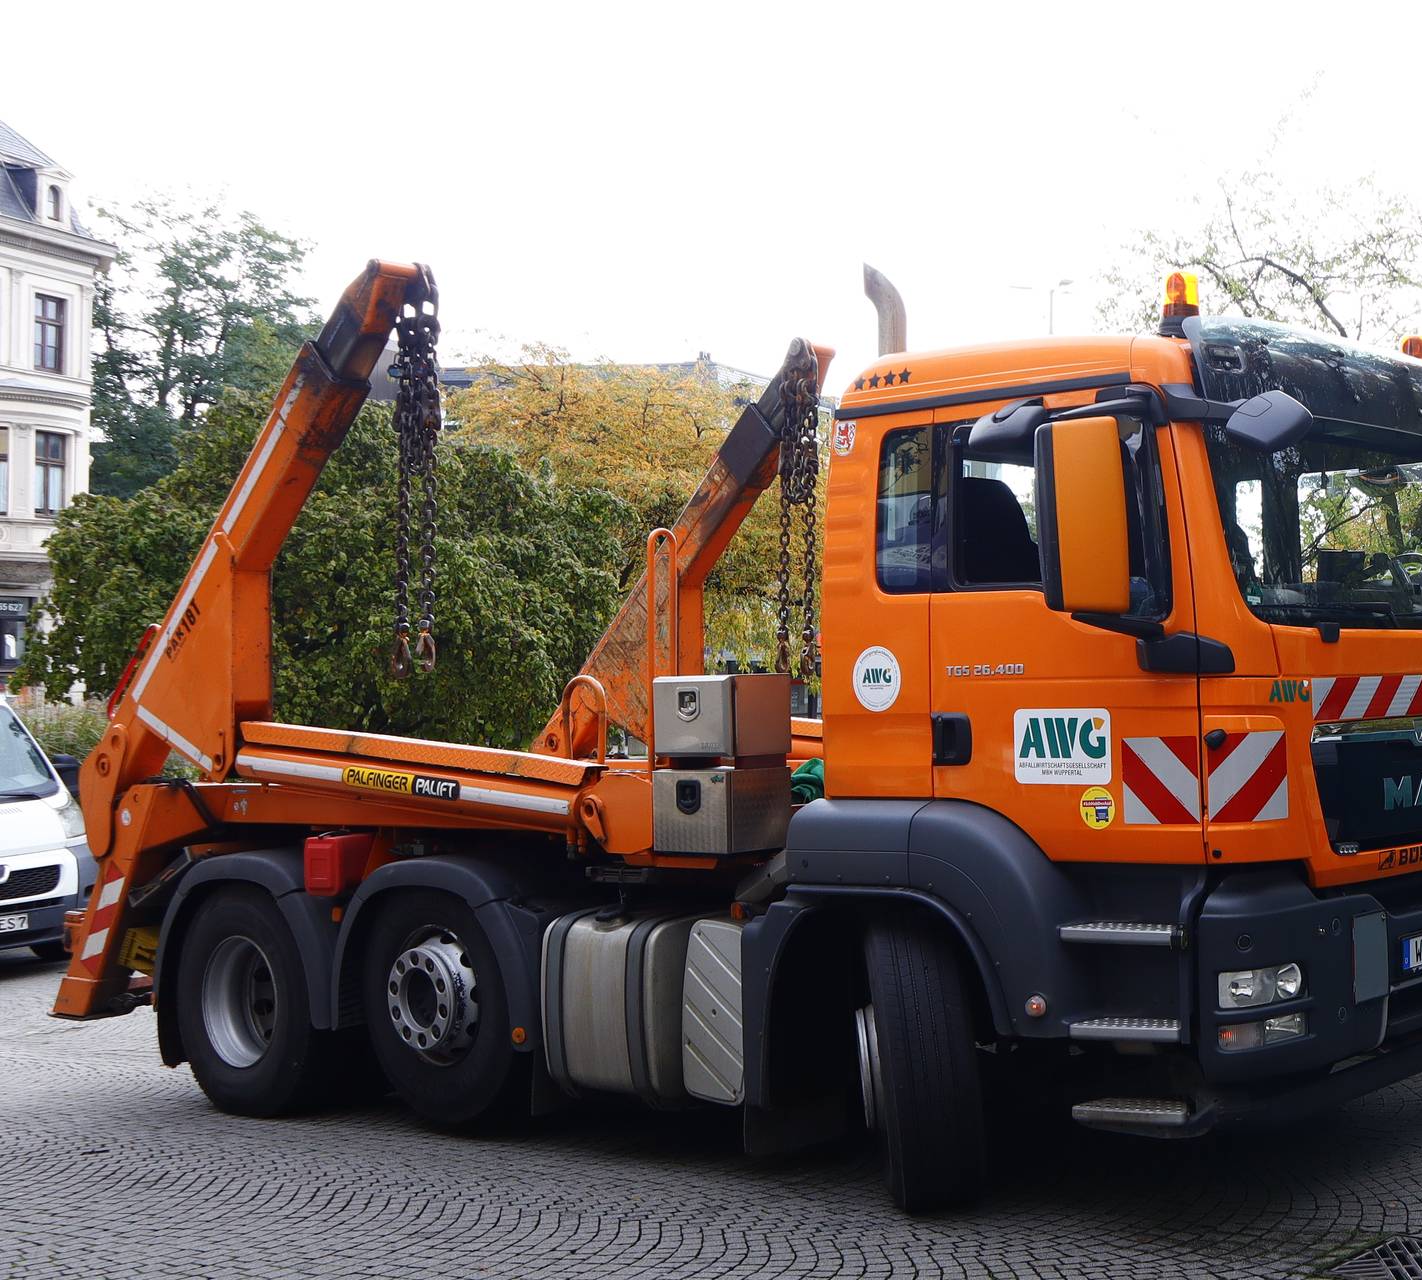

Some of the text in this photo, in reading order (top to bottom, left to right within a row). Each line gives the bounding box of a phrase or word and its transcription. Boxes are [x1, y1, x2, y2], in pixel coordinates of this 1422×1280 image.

[862, 668, 892, 684] AWG
[945, 664, 1025, 677] TGS 26.400
[1269, 679, 1310, 703] AWG
[1019, 717, 1106, 759] AWG
[1019, 761, 1107, 769] ABFALLWIRTSCHAFTSGESELLSCHAFT
[346, 768, 457, 798] PALFINGER PALIFT
[1415, 938, 1422, 962] W
